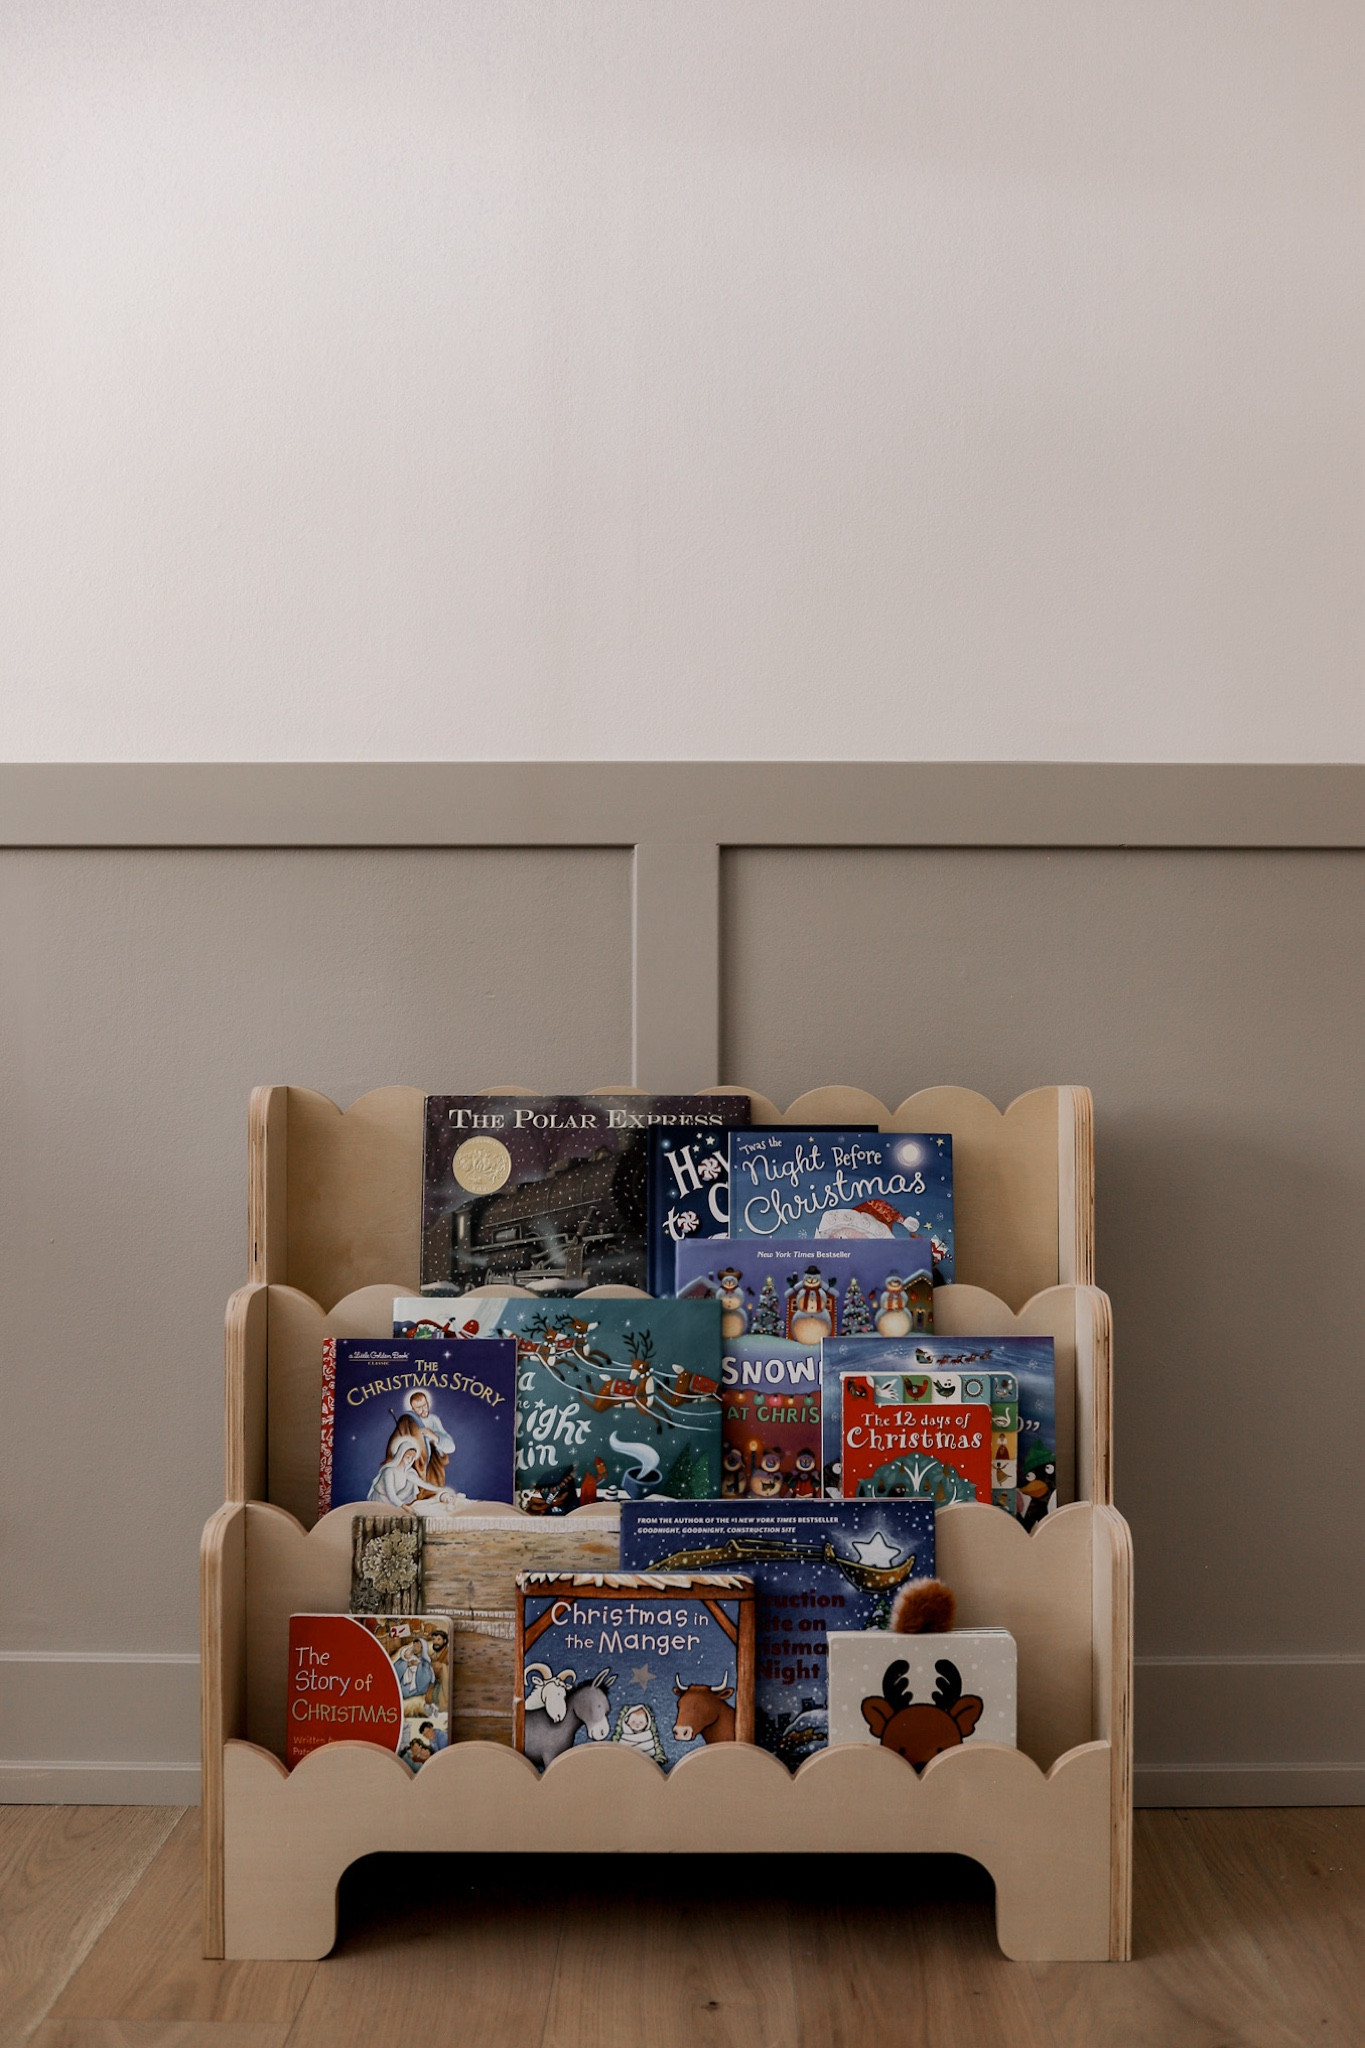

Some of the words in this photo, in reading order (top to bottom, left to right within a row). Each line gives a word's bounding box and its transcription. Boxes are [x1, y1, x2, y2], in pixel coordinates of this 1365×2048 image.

[449, 1109, 505, 1129] THE
[513, 1109, 597, 1129] POLAR
[606, 1109, 723, 1129] EXPRESS
[768, 1136, 782, 1148] the
[742, 1144, 825, 1187] Night
[831, 1143, 882, 1170] Before
[744, 1169, 926, 1235] Christmas
[757, 1250, 773, 1258] New
[775, 1250, 791, 1258] York
[793, 1250, 815, 1258] Times
[816, 1250, 851, 1258] Bestseller
[415, 1359, 438, 1372] THE
[346, 1373, 449, 1407] CHRISTMAS
[450, 1372, 505, 1407] STORY
[518, 1371, 536, 1391] a
[727, 1406, 748, 1421] AT
[861, 1413, 890, 1427] The
[893, 1411, 916, 1426] 12
[921, 1413, 951, 1430] days
[955, 1413, 971, 1429] of
[846, 1426, 983, 1451] Christmas
[798, 1516, 839, 1524] BESTSELLER
[551, 1601, 688, 1627] Christmas
[694, 1613, 709, 1626] in
[798, 1618, 826, 1632] on
[565, 1633, 594, 1649] the
[598, 1630, 701, 1656] Manger
[295, 1646, 330, 1667] The
[295, 1668, 351, 1697] Story
[354, 1673, 373, 1692] of
[291, 1698, 399, 1724] CHRISTMAS
